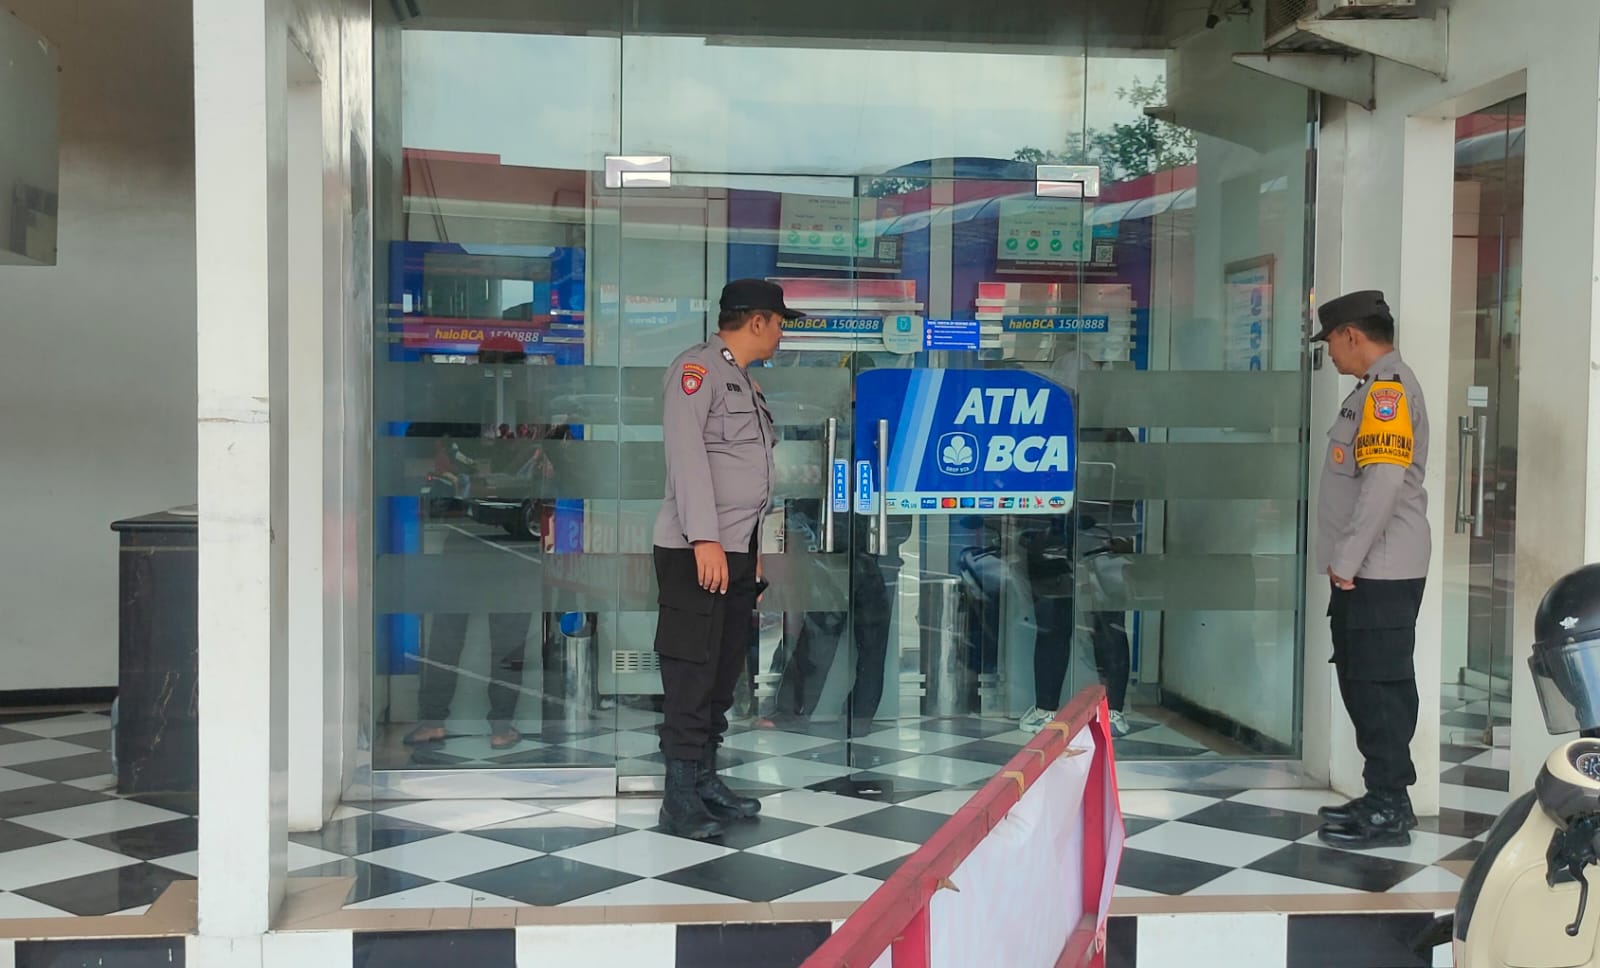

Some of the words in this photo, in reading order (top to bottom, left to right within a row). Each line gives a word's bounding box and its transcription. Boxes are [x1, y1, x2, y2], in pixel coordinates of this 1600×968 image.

[434, 328, 484, 340] haloBCA
[780, 318, 828, 329] haloBCA
[831, 319, 880, 330] 1500888
[1008, 319, 1055, 330] haloBCA
[1058, 319, 1105, 330] 1500888
[953, 387, 1050, 425] ATM
[983, 435, 1069, 473] BCA
[836, 464, 844, 499] TARIK
[861, 464, 869, 499] TARIK
